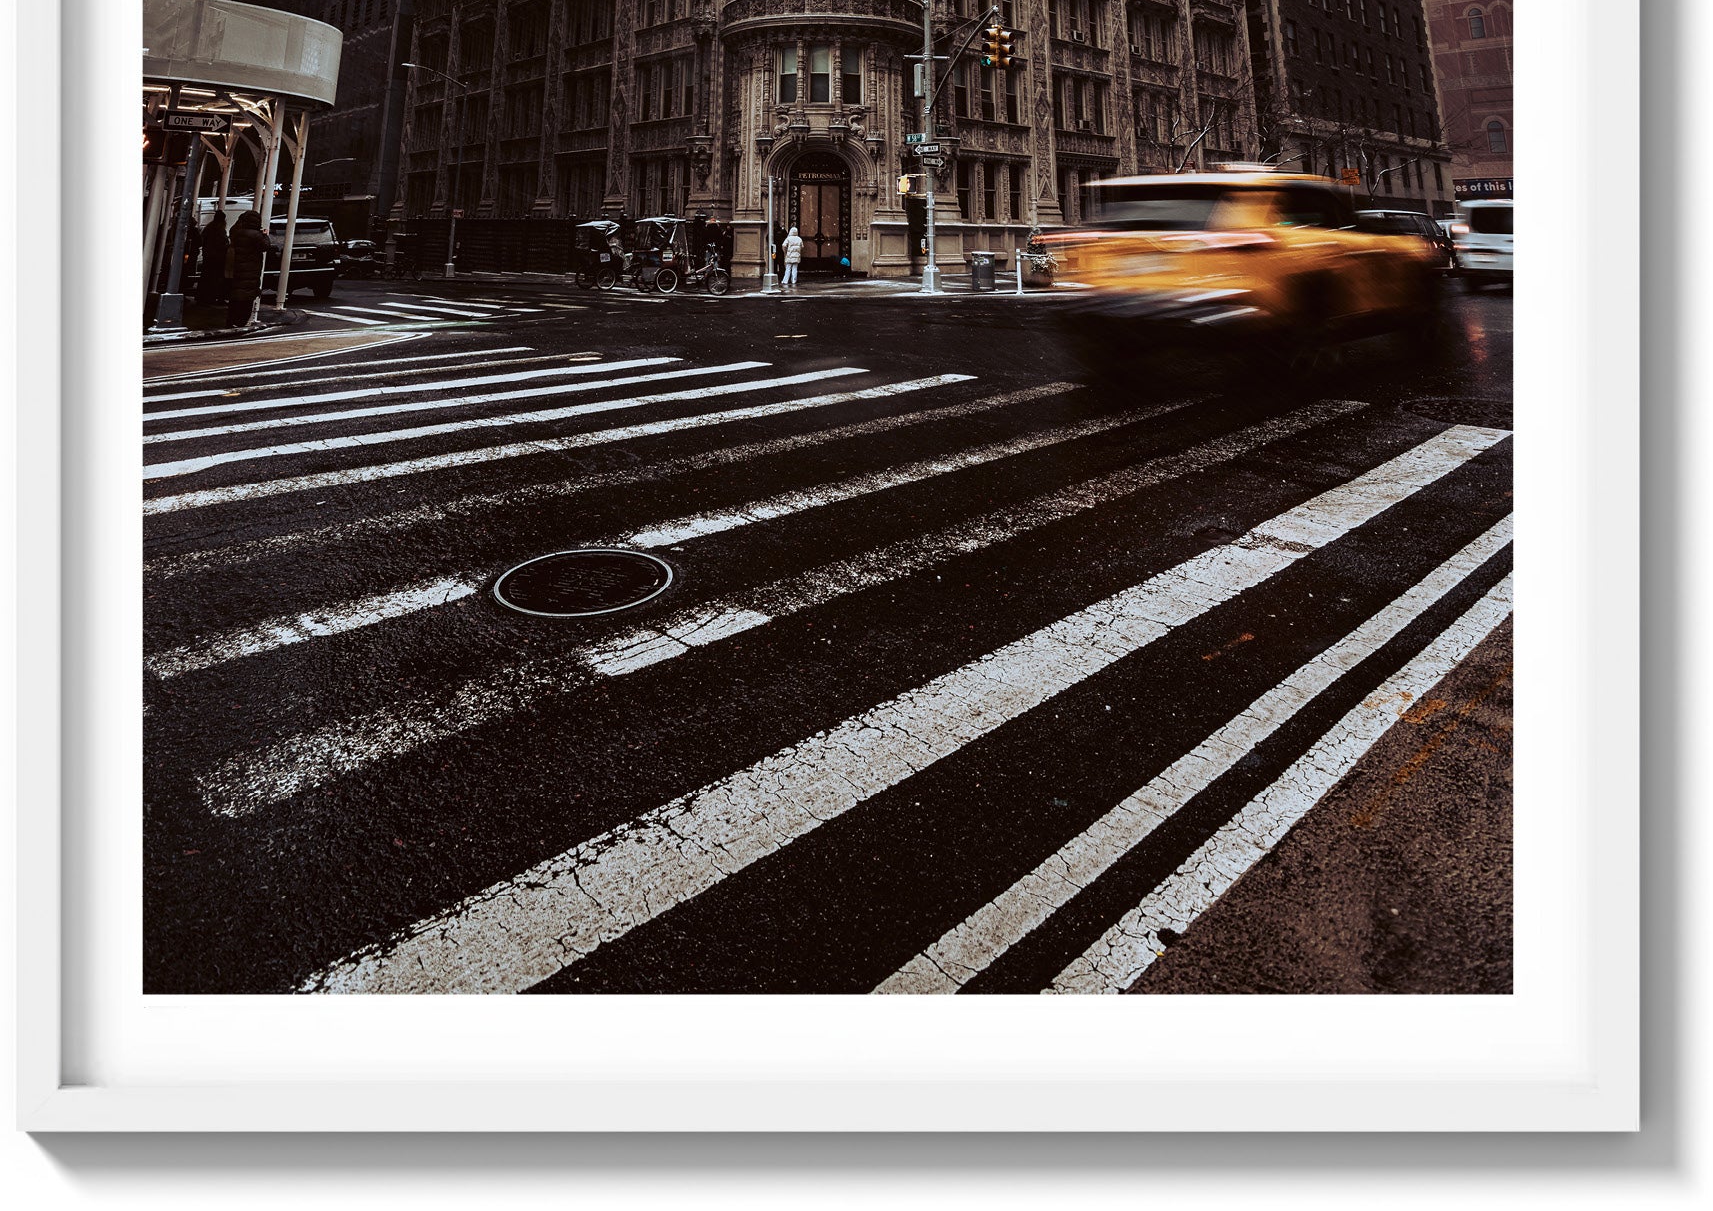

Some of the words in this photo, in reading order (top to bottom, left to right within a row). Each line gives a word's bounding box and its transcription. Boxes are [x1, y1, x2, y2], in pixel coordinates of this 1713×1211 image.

[174, 116, 194, 126] ONE
[202, 117, 222, 127] WAY
[1470, 182, 1482, 191] of
[1484, 181, 1506, 191] this
